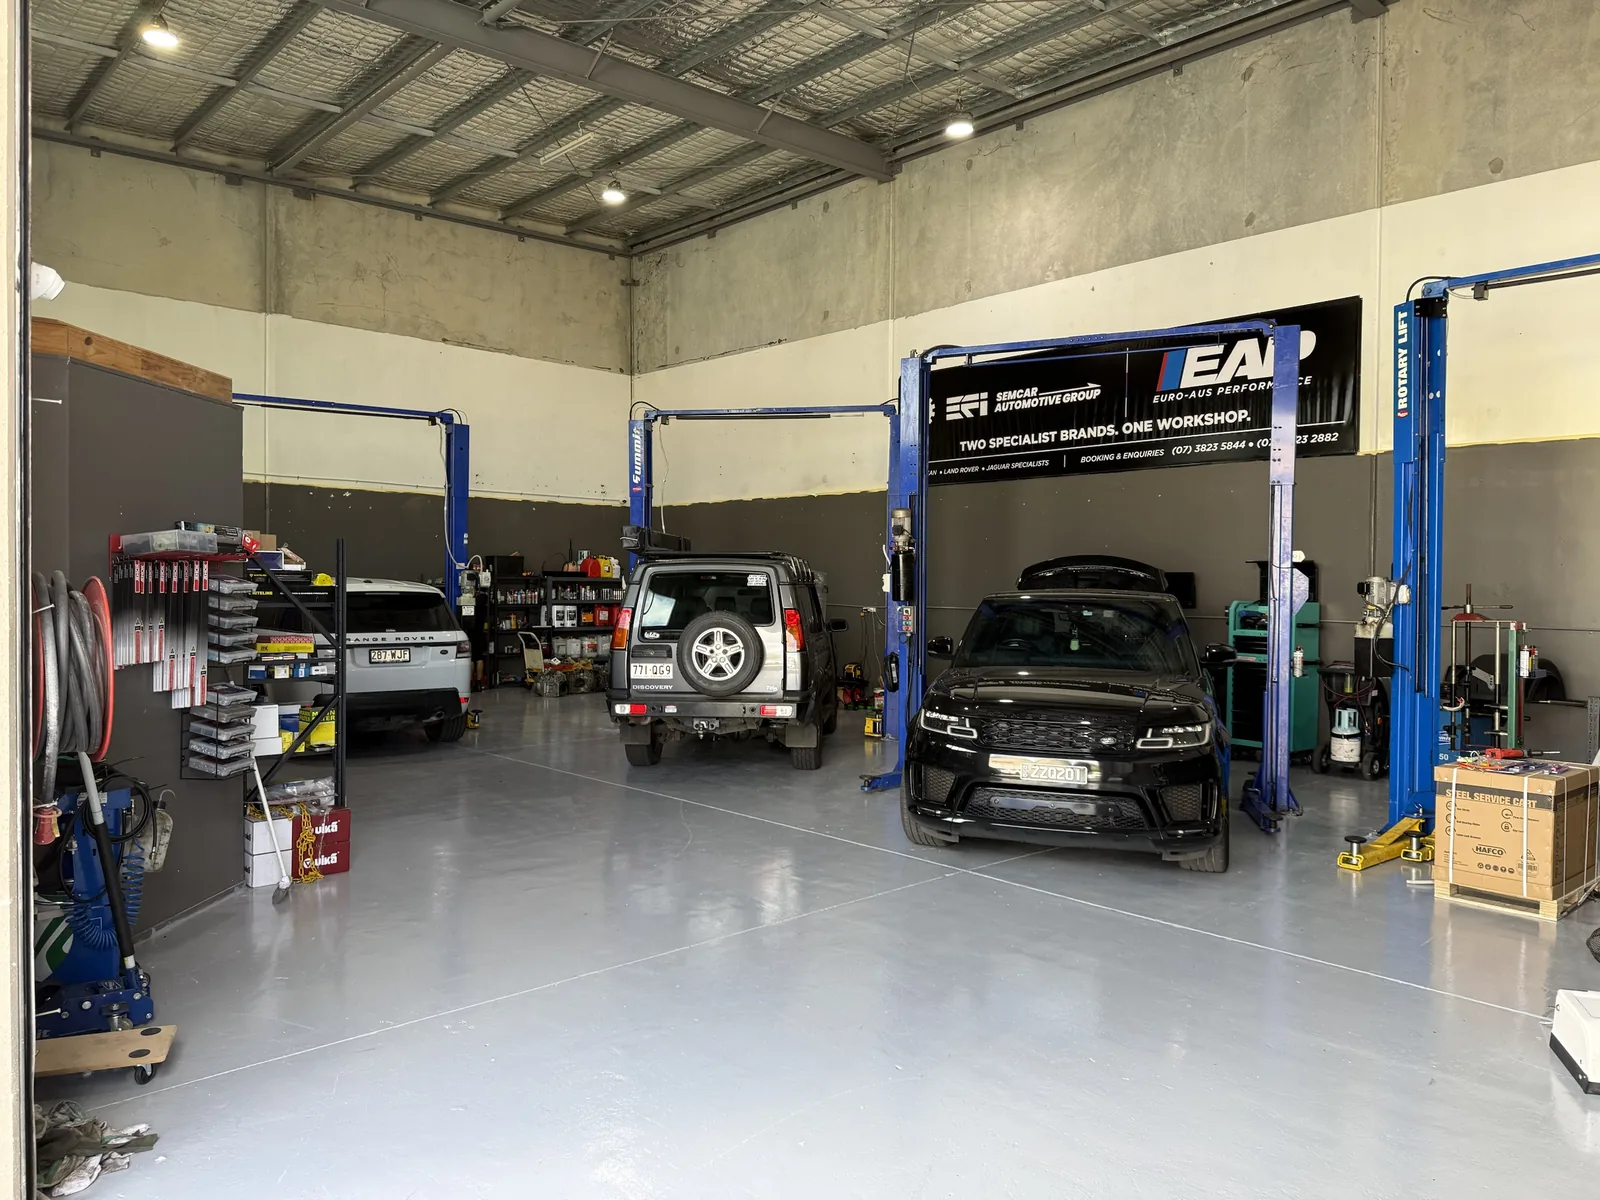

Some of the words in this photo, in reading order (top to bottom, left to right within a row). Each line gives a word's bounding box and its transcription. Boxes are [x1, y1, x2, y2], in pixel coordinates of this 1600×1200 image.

[1397, 311, 1408, 344] LIFT
[1397, 348, 1408, 410] ROTARY
[996, 386, 1039, 402] SEMCAR
[1153, 388, 1213, 404] EURO-AUS
[1217, 376, 1313, 396] PERFORMCE
[994, 394, 1062, 413] AUTOMOTIVE
[1062, 388, 1102, 404] GROUP
[959, 438, 987, 452] TWO
[988, 431, 1058, 449] SPECIALIST
[1060, 424, 1119, 441] BRANDS.
[1121, 420, 1153, 435] ONE
[1156, 409, 1251, 431] WORKSHOP.
[1309, 432, 1340, 443] 2882
[1080, 453, 1115, 464] BOOKING
[1115, 452, 1122, 460] &
[1122, 448, 1165, 460] ENQUIRIES
[1171, 446, 1192, 456] (07)
[1194, 443, 1219, 453] 3823
[1220, 439, 1246, 450] 5844
[943, 467, 959, 475] LAND
[959, 465, 980, 474] ROVER
[986, 462, 1011, 471] JAGUAR
[1010, 459, 1050, 469] SPECIALISTS
[1445, 788, 1472, 800] SEEL
[1473, 792, 1511, 805] SERVICE
[1475, 845, 1504, 856] HAFCO
